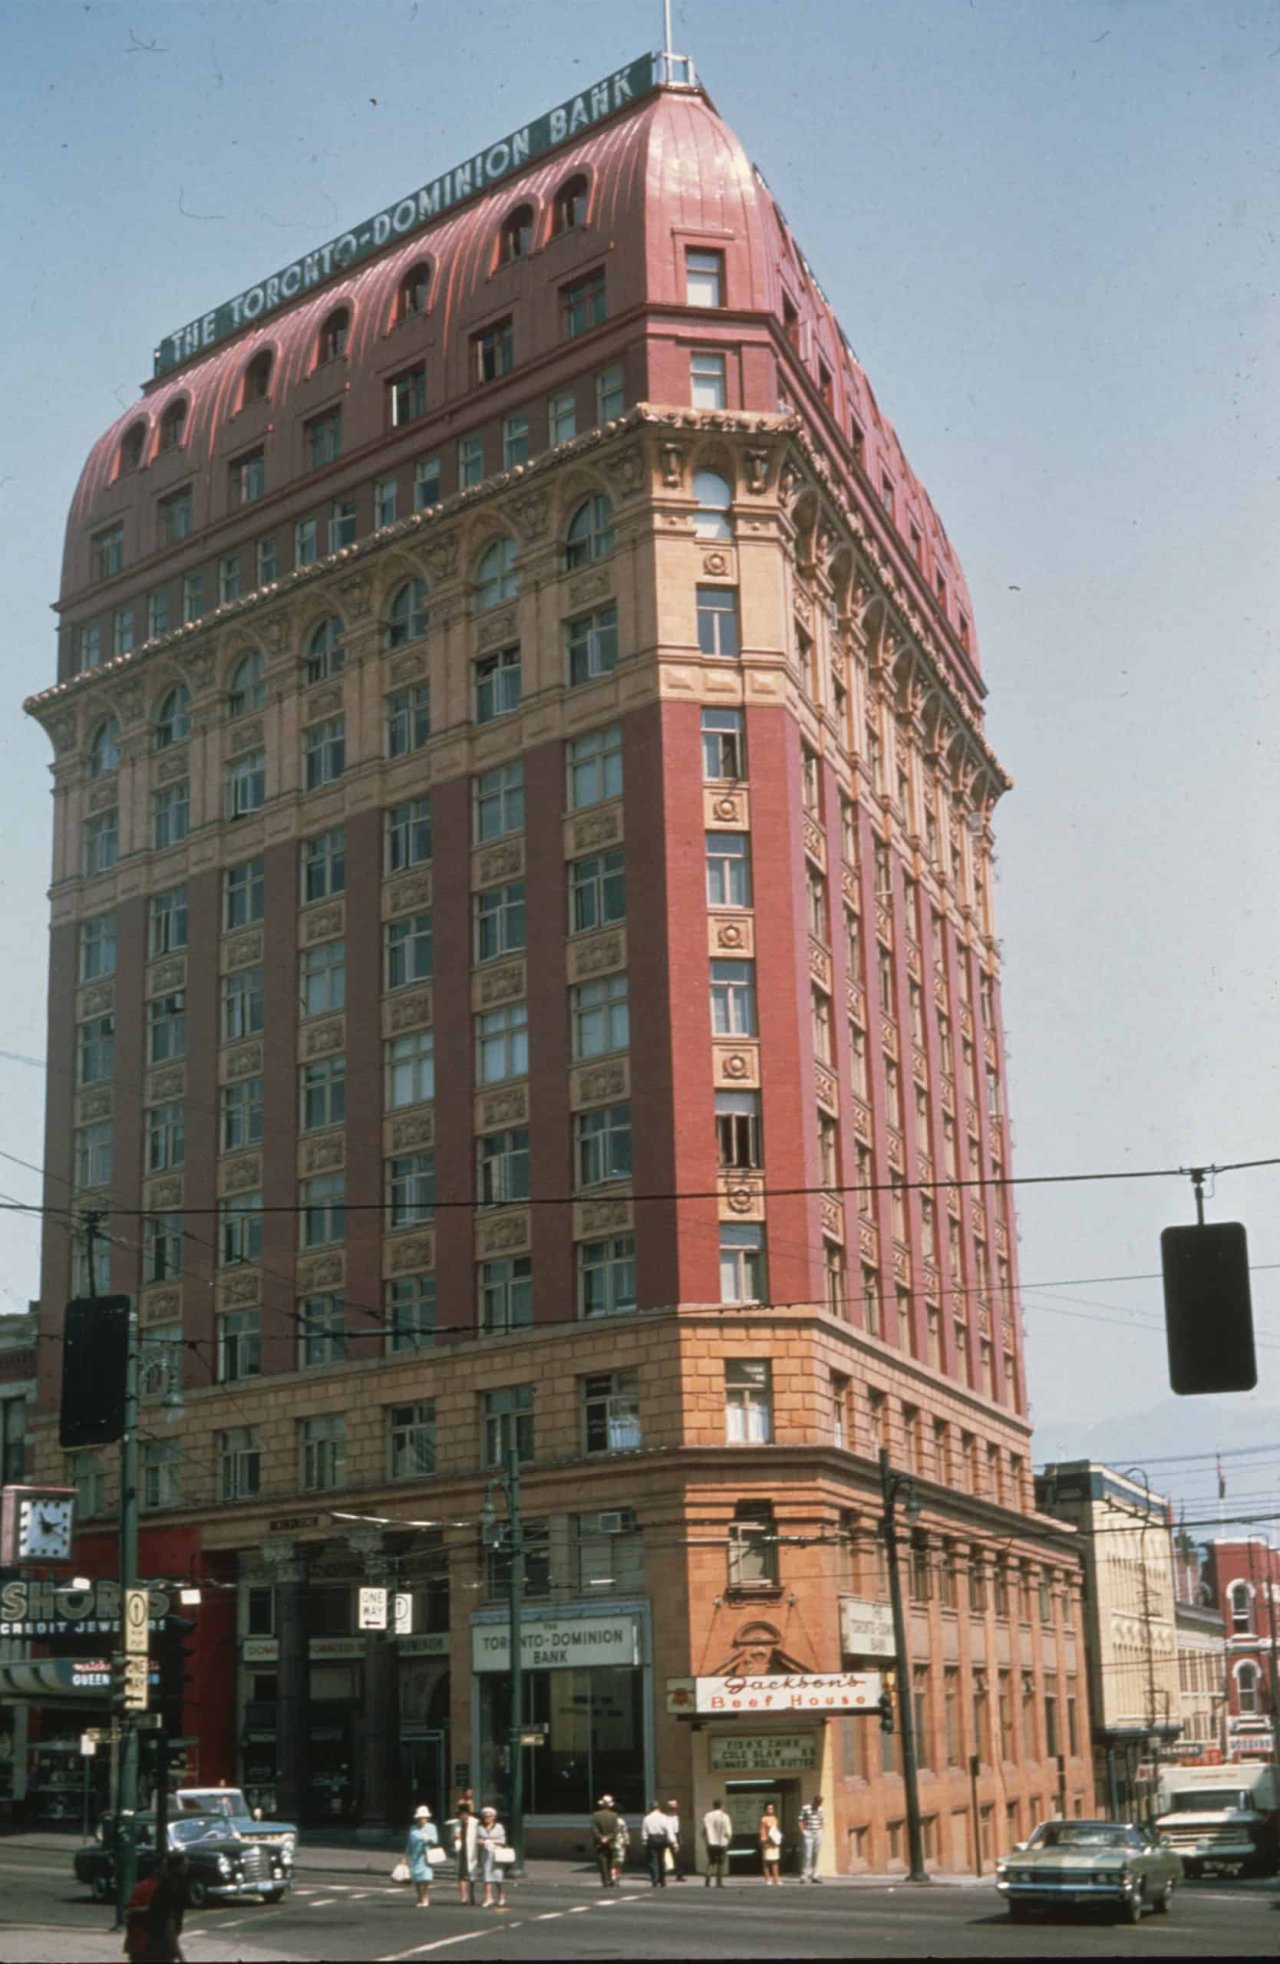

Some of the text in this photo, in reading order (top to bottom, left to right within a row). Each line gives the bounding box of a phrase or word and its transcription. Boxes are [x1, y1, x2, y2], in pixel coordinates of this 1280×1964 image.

[172, 67, 634, 362] THE TORONTO-DOMINION BANK
[2, 1581, 170, 1622] SHORS
[362, 1592, 384, 1604] ONE
[362, 1605, 384, 1617] WAY
[1, 1621, 68, 1635] CREDIT
[483, 1629, 624, 1651] TORNTO-DOMINION
[533, 1650, 569, 1665] BANK
[72, 1673, 111, 1686] QUEEN
[724, 1674, 867, 1695] Jackson's
[711, 1694, 866, 1709] Beef House
